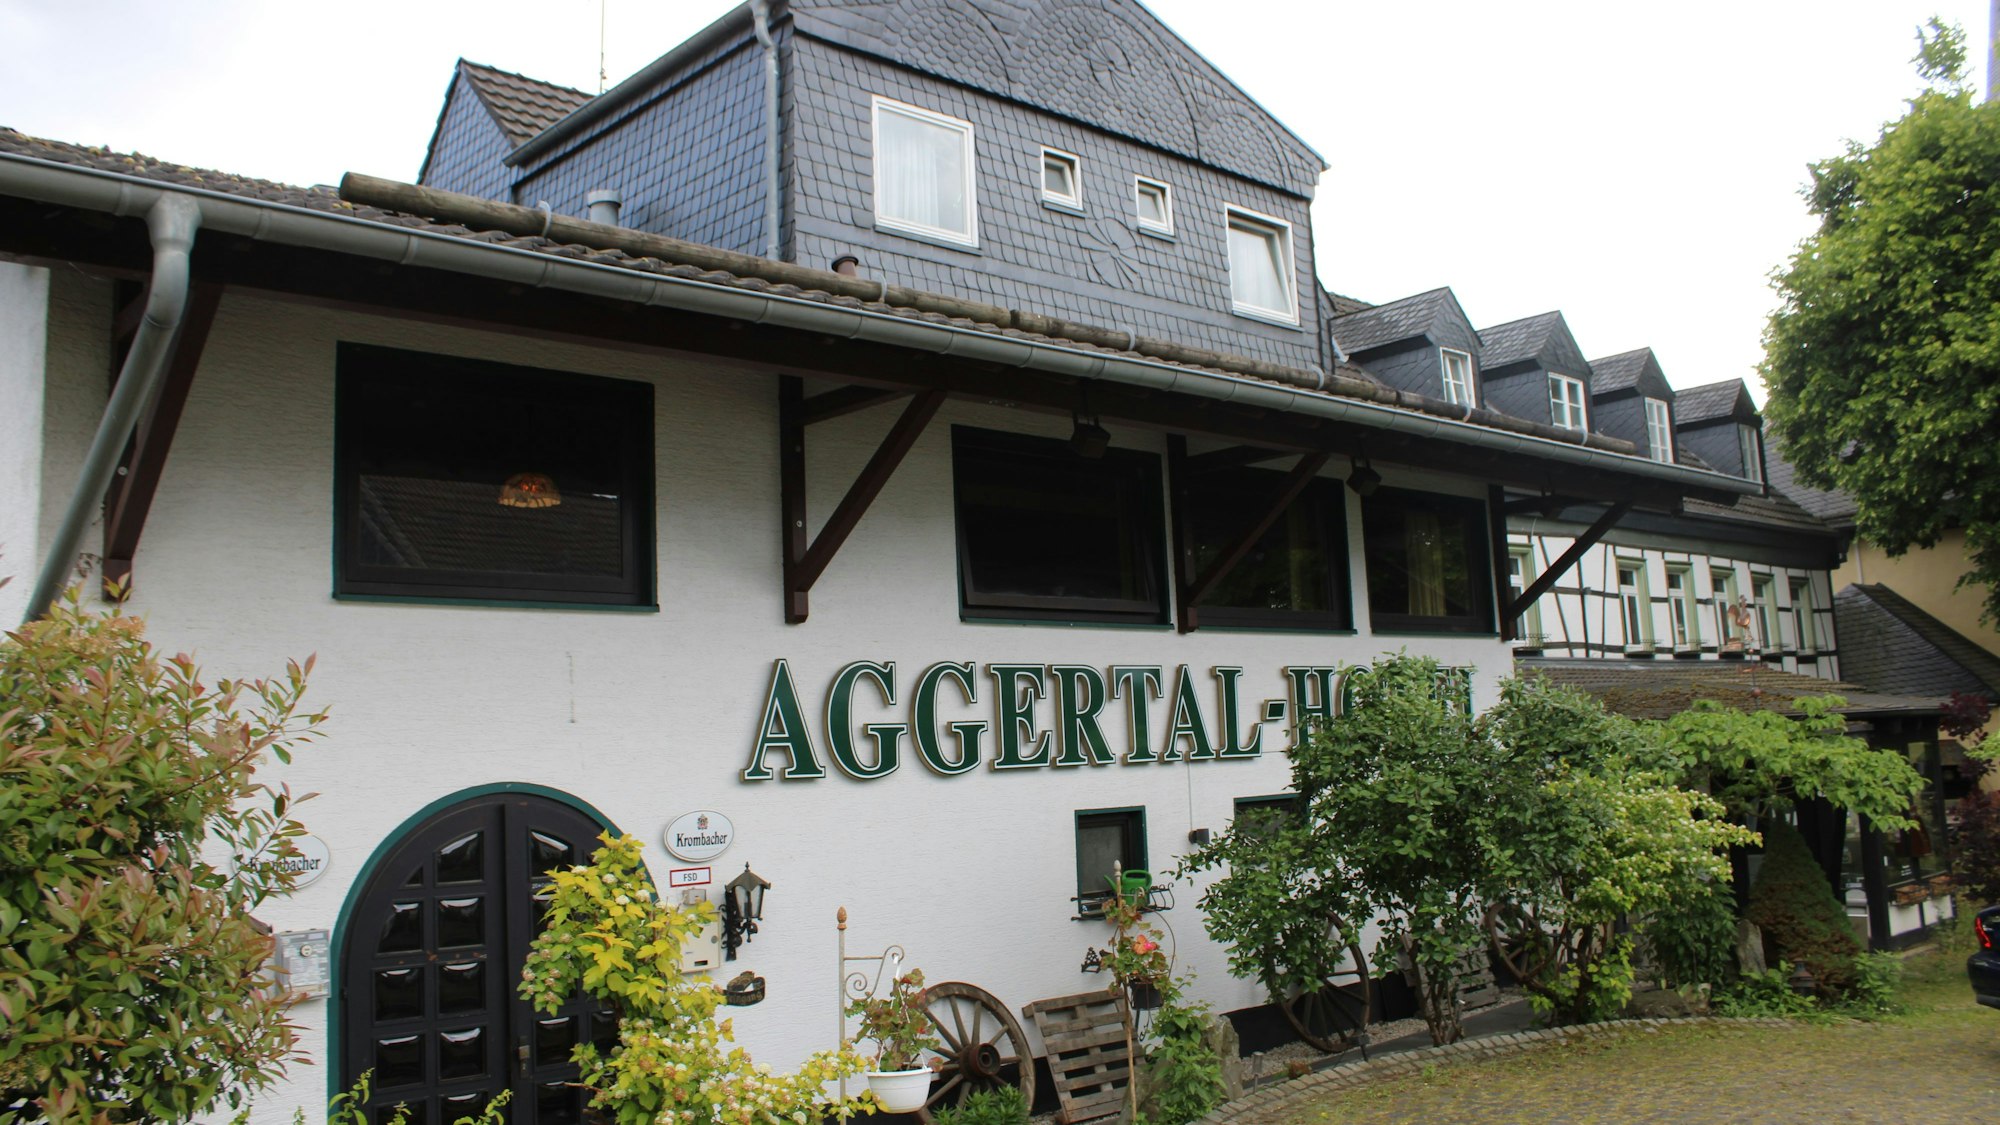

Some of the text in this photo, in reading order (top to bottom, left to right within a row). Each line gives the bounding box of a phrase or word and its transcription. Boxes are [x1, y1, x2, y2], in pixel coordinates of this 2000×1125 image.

[740, 658, 1481, 781] AGGERTAL-H
[676, 832, 727, 847] Krombacher
[250, 855, 321, 872] Kbacher
[683, 872, 698, 882] FSD
